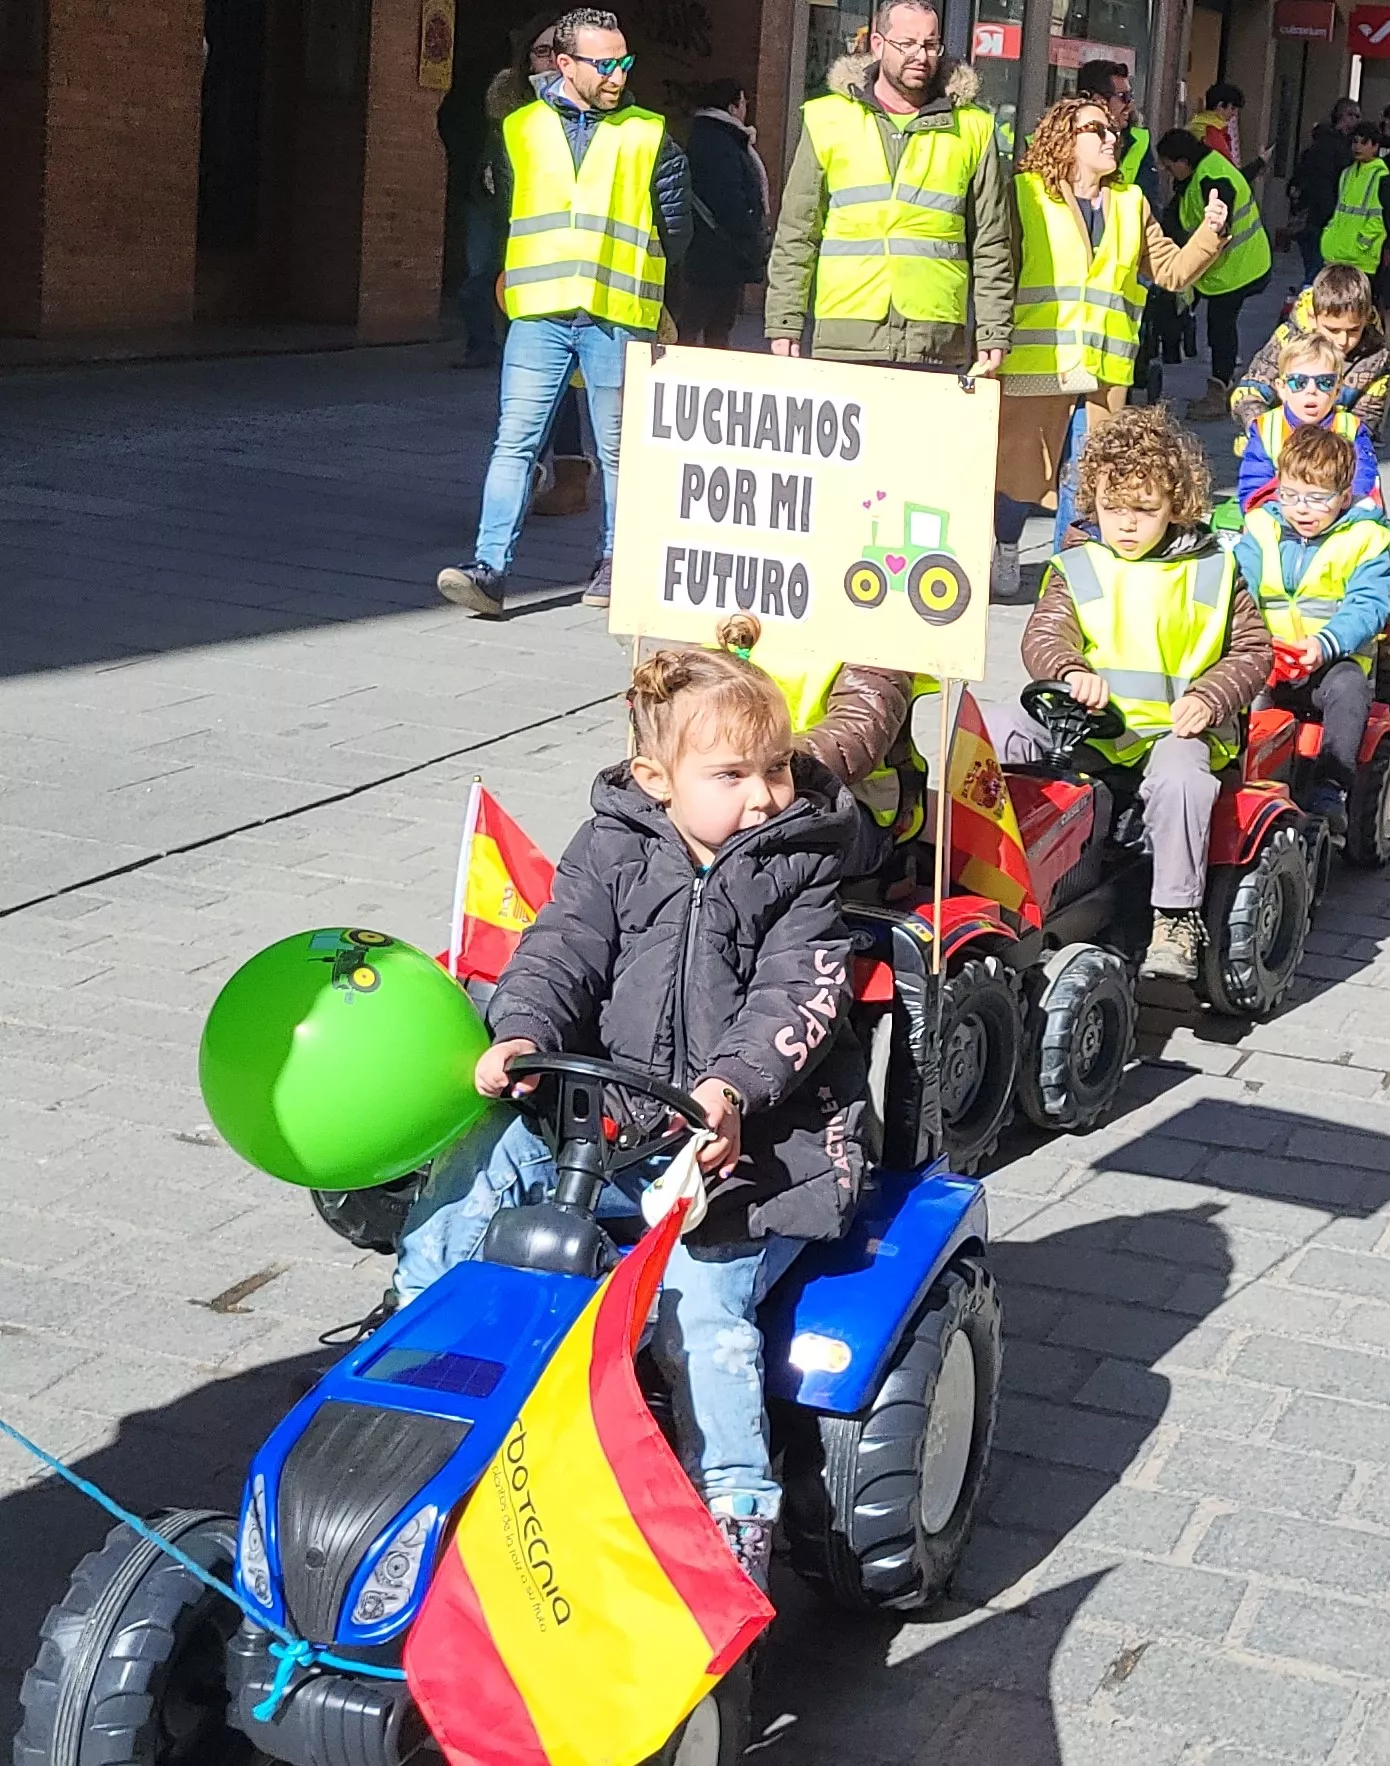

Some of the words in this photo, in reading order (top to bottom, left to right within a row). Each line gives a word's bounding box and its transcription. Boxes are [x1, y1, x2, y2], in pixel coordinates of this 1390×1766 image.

[652, 381, 862, 461] LUCHAMOS
[680, 463, 757, 526] POR
[769, 472, 813, 533] MI
[663, 546, 809, 619] FUTURO
